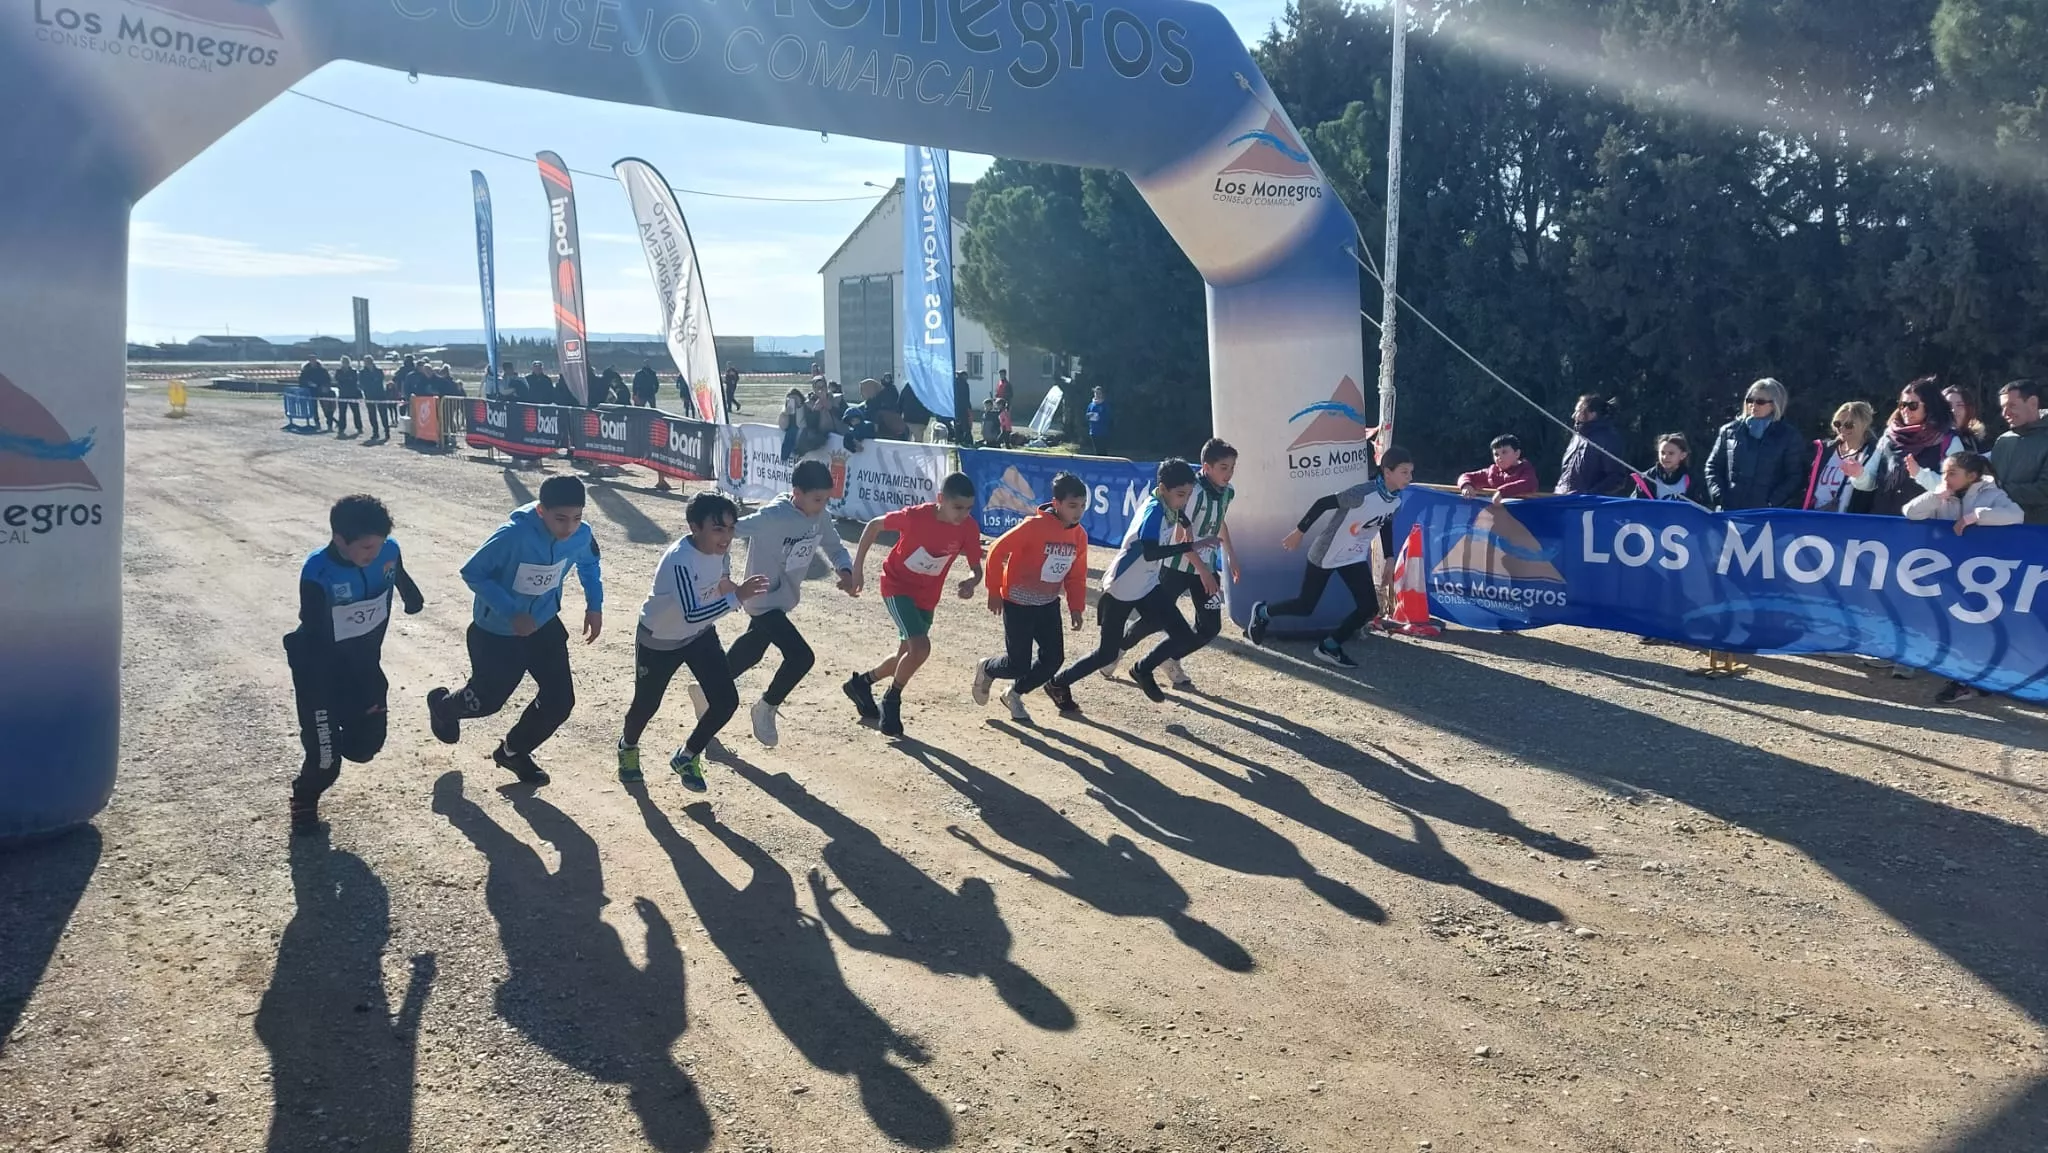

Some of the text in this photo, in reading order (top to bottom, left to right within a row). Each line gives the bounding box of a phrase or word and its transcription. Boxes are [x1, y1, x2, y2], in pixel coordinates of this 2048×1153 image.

[34, 0, 278, 67] Los Monegros
[34, 26, 213, 73] CONSEJO COMARCAL
[723, 25, 996, 112] COMARCAL
[1212, 193, 1296, 207] CONSEJO COMARCAL
[1214, 177, 1322, 202] Los Monegros
[486, 402, 507, 429] barri
[537, 408, 559, 435] barri
[599, 413, 628, 441] barri
[669, 422, 702, 460] barri
[1288, 454, 1322, 470] Los
[1289, 467, 1331, 479] CONSEJO
[857, 469, 933, 492] AYUNTAMIENTO
[858, 487, 872, 501] DE
[1433, 576, 1567, 607] Los Monegros
